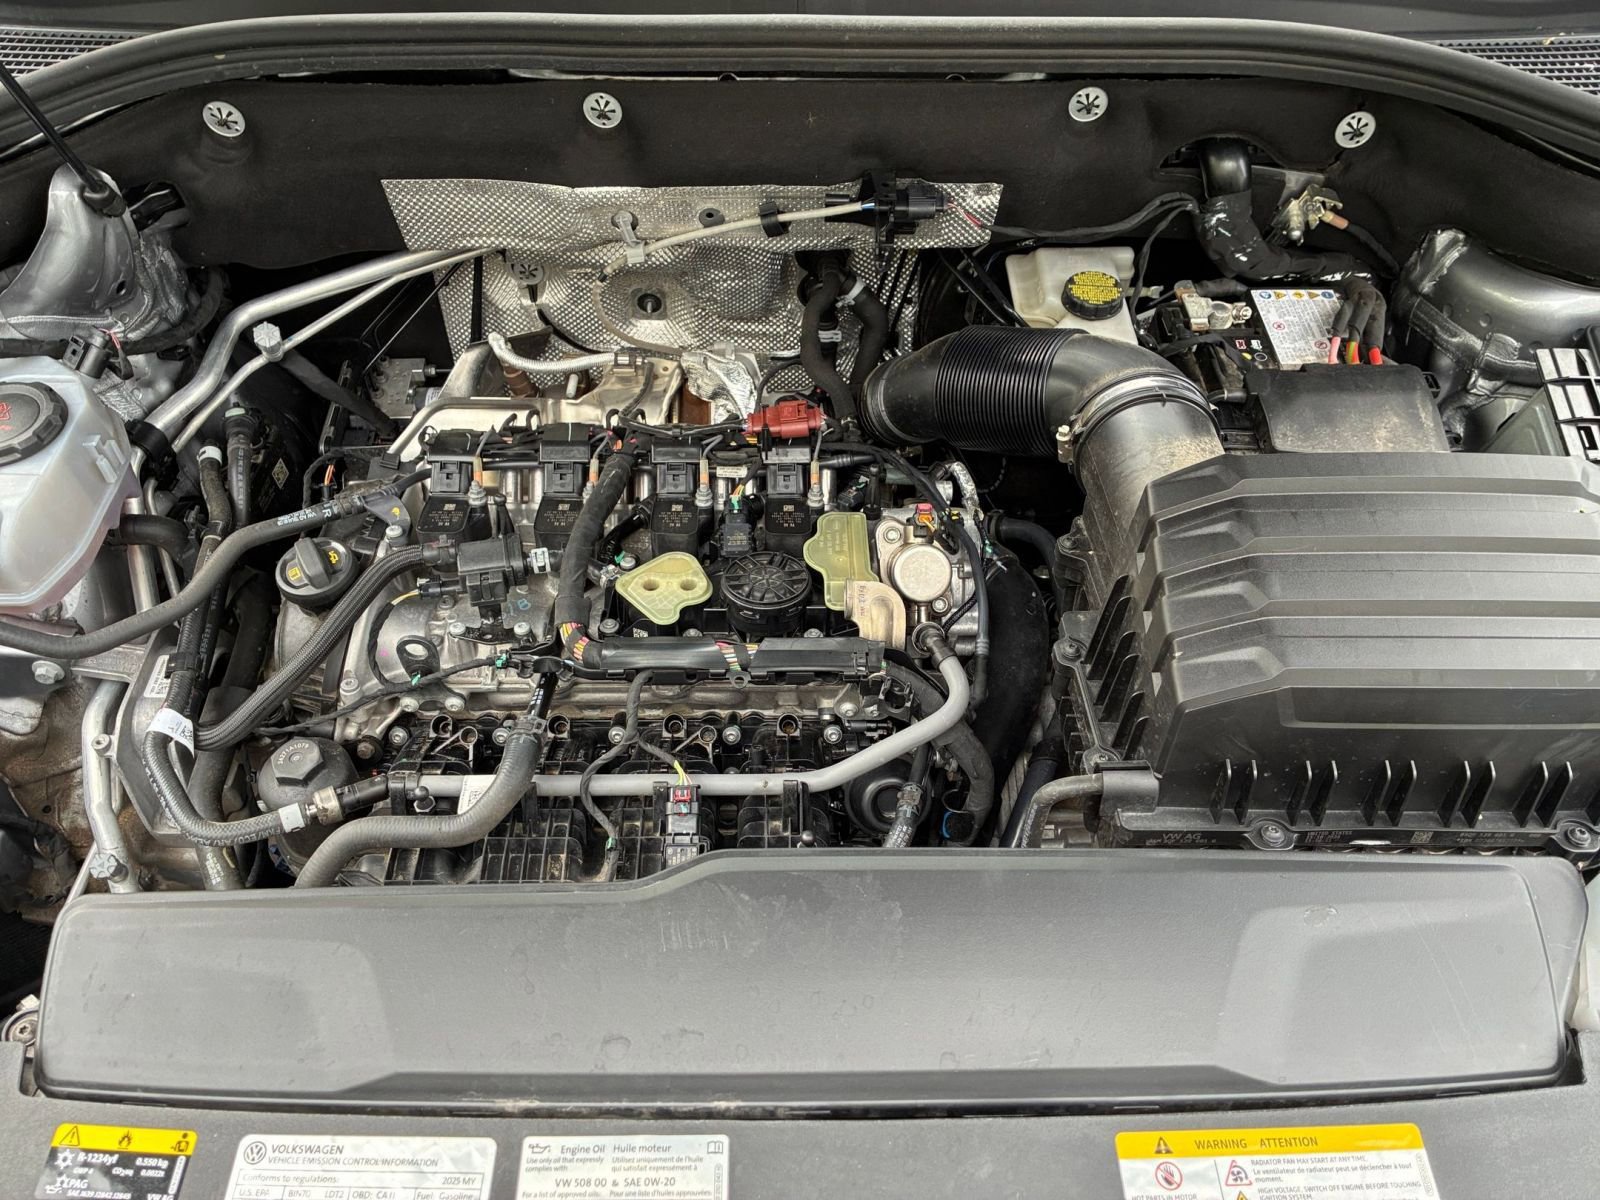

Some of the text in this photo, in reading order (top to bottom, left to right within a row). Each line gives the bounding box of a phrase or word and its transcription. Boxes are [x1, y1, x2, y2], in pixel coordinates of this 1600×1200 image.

[1194, 1136, 1319, 1150] WARNING ATTENTION
[271, 1144, 344, 1155] VOLKSWAGEN
[560, 1143, 606, 1156] Engine Oil
[613, 1143, 672, 1153] Huile moteur
[77, 1152, 120, 1166] R-1234yf
[136, 1157, 169, 1169] 0.550 kg
[268, 1156, 439, 1167] VEHICLE EMISSION CONTROL INFORMATION
[538, 1157, 552, 1165] only
[562, 1156, 575, 1164] that
[575, 1156, 604, 1165] expressly
[636, 1157, 674, 1165] uniquement
[1251, 1158, 1282, 1166] RADIATOR
[525, 1165, 552, 1173] complies
[611, 1165, 622, 1173] qui
[623, 1164, 647, 1172] satisfait
[1262, 1167, 1296, 1175] ventilateur
[1306, 1166, 1335, 1174] radiateur
[442, 1176, 477, 1185] 2025 MY
[554, 1178, 572, 1187] VW
[574, 1178, 592, 1187] 508
[594, 1178, 607, 1187] 00
[624, 1177, 641, 1187] SAE
[644, 1177, 676, 1187] 0W-20
[1328, 1184, 1340, 1192] OFF
[352, 1191, 373, 1199] OBD:
[376, 1191, 388, 1199] CA
[439, 1192, 473, 1200] Gasoline
[556, 1190, 586, 1199] approved
